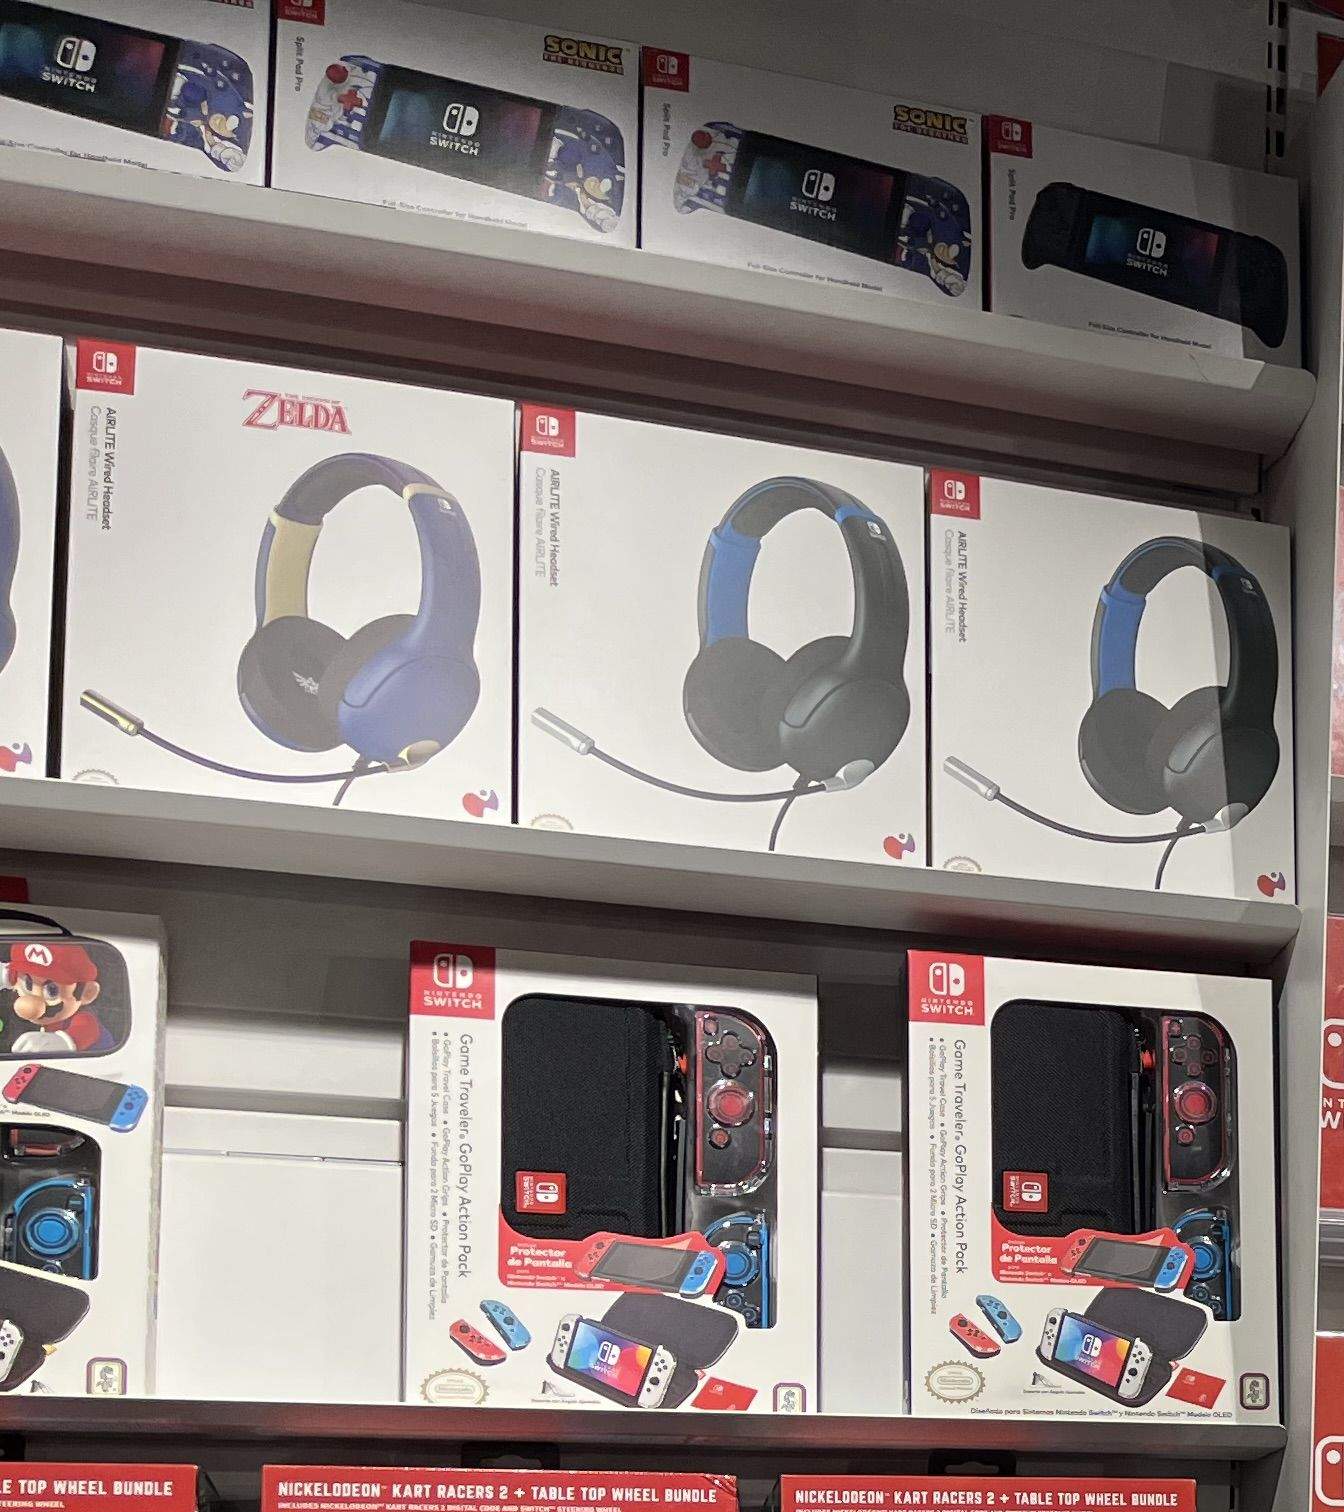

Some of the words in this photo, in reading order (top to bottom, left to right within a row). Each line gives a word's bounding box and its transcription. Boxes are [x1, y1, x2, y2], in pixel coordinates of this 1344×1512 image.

[105, 407, 118, 450] AIRLITE
[242, 389, 352, 435] ZELDA
[103, 452, 115, 485] Wired
[550, 469, 560, 509] AIRLITE
[101, 486, 114, 531] Headset
[549, 512, 559, 542] Wired
[549, 544, 559, 588] Headset
[423, 996, 482, 1010] SWITCH
[920, 1003, 974, 1017] SWITCH
[459, 1034, 473, 1076] Game
[954, 1040, 966, 1079] Game
[456, 1143, 473, 1193] GoPlay
[459, 1195, 472, 1240] Action
[459, 1245, 472, 1279] Pack
[956, 1241, 967, 1274] Pack
[19, 1479, 45, 1495] TOP
[53, 1479, 107, 1495] WHEEL
[114, 1480, 173, 1496] BUNDLE
[278, 1482, 382, 1498] NICKELODEON
[392, 1483, 432, 1499] KART
[437, 1484, 493, 1500] RACERS
[499, 1485, 508, 1500] 2
[531, 1486, 575, 1501] TABLE
[581, 1487, 607, 1502] TOP
[611, 1487, 660, 1502] WHEEL
[665, 1488, 717, 1503] BUNDLE
[796, 1489, 885, 1504] NICKELODEON
[894, 1490, 928, 1505] KART
[934, 1491, 982, 1505] RACERS
[987, 1491, 996, 1505] 2
[1015, 1491, 1053, 1506] TABLE
[1058, 1492, 1081, 1506] TOP
[1085, 1492, 1127, 1506] WHEEL
[1131, 1492, 1179, 1507] BUNDLE
